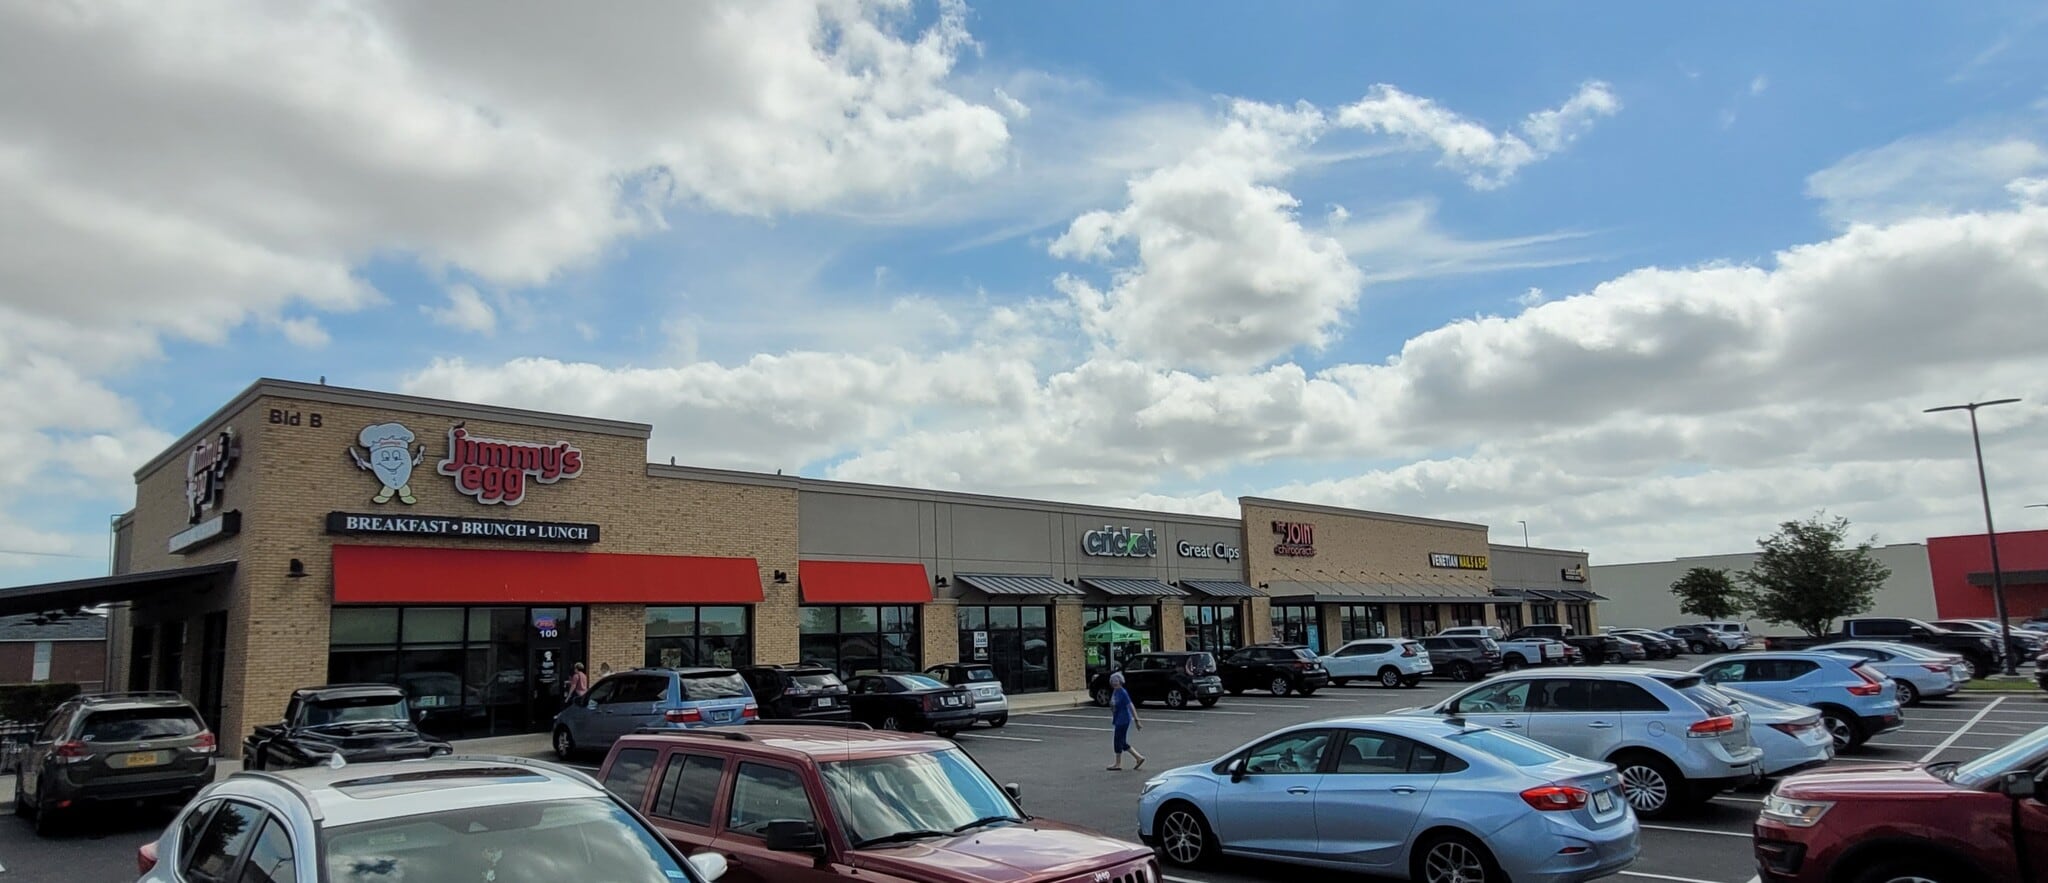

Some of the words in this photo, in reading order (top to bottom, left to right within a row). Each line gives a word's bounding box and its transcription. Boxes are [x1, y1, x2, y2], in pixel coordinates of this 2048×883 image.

[270, 408, 301, 426] Bld
[310, 413, 322, 428] B
[443, 429, 581, 479] jimmy's
[461, 465, 524, 501] egg
[346, 516, 450, 533] BREAKFAST
[461, 521, 527, 537] BRUNCH
[538, 525, 588, 540] LUNCH
[1084, 525, 1156, 558] cricket
[1178, 540, 1212, 558] Great
[1215, 542, 1240, 563] Clips
[540, 629, 558, 638] 100
[1094, 870, 1111, 883] Jeep
